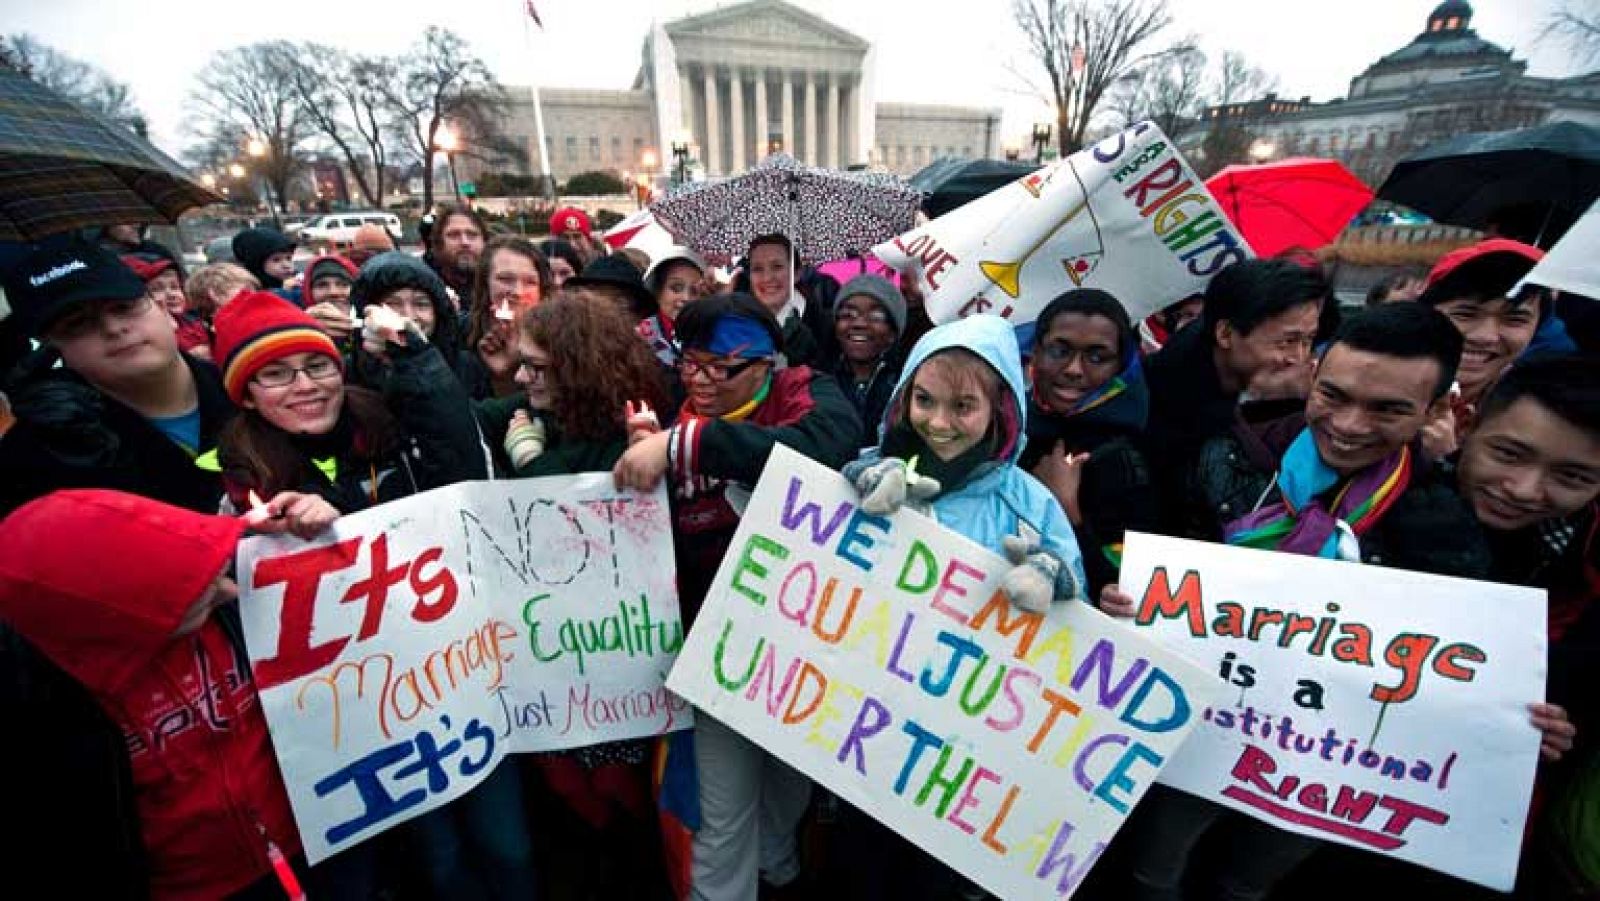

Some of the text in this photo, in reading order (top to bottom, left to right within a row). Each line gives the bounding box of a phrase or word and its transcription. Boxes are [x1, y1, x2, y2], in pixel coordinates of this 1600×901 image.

[893, 234, 959, 291] LOVE
[1125, 157, 1245, 277] RIGHTS
[253, 497, 634, 690] Its NOT
[780, 475, 1193, 734] WE DEMAND
[1134, 565, 1487, 704] Marriage
[298, 617, 518, 751] Marriage
[711, 619, 892, 776] UNDER
[892, 719, 1002, 835] THE
[730, 533, 1165, 815] EQUAL JUSTICE
[1218, 651, 1325, 711] is a
[314, 714, 495, 846] It's
[498, 686, 557, 738] Just
[1230, 742, 1450, 836] RIGHT
